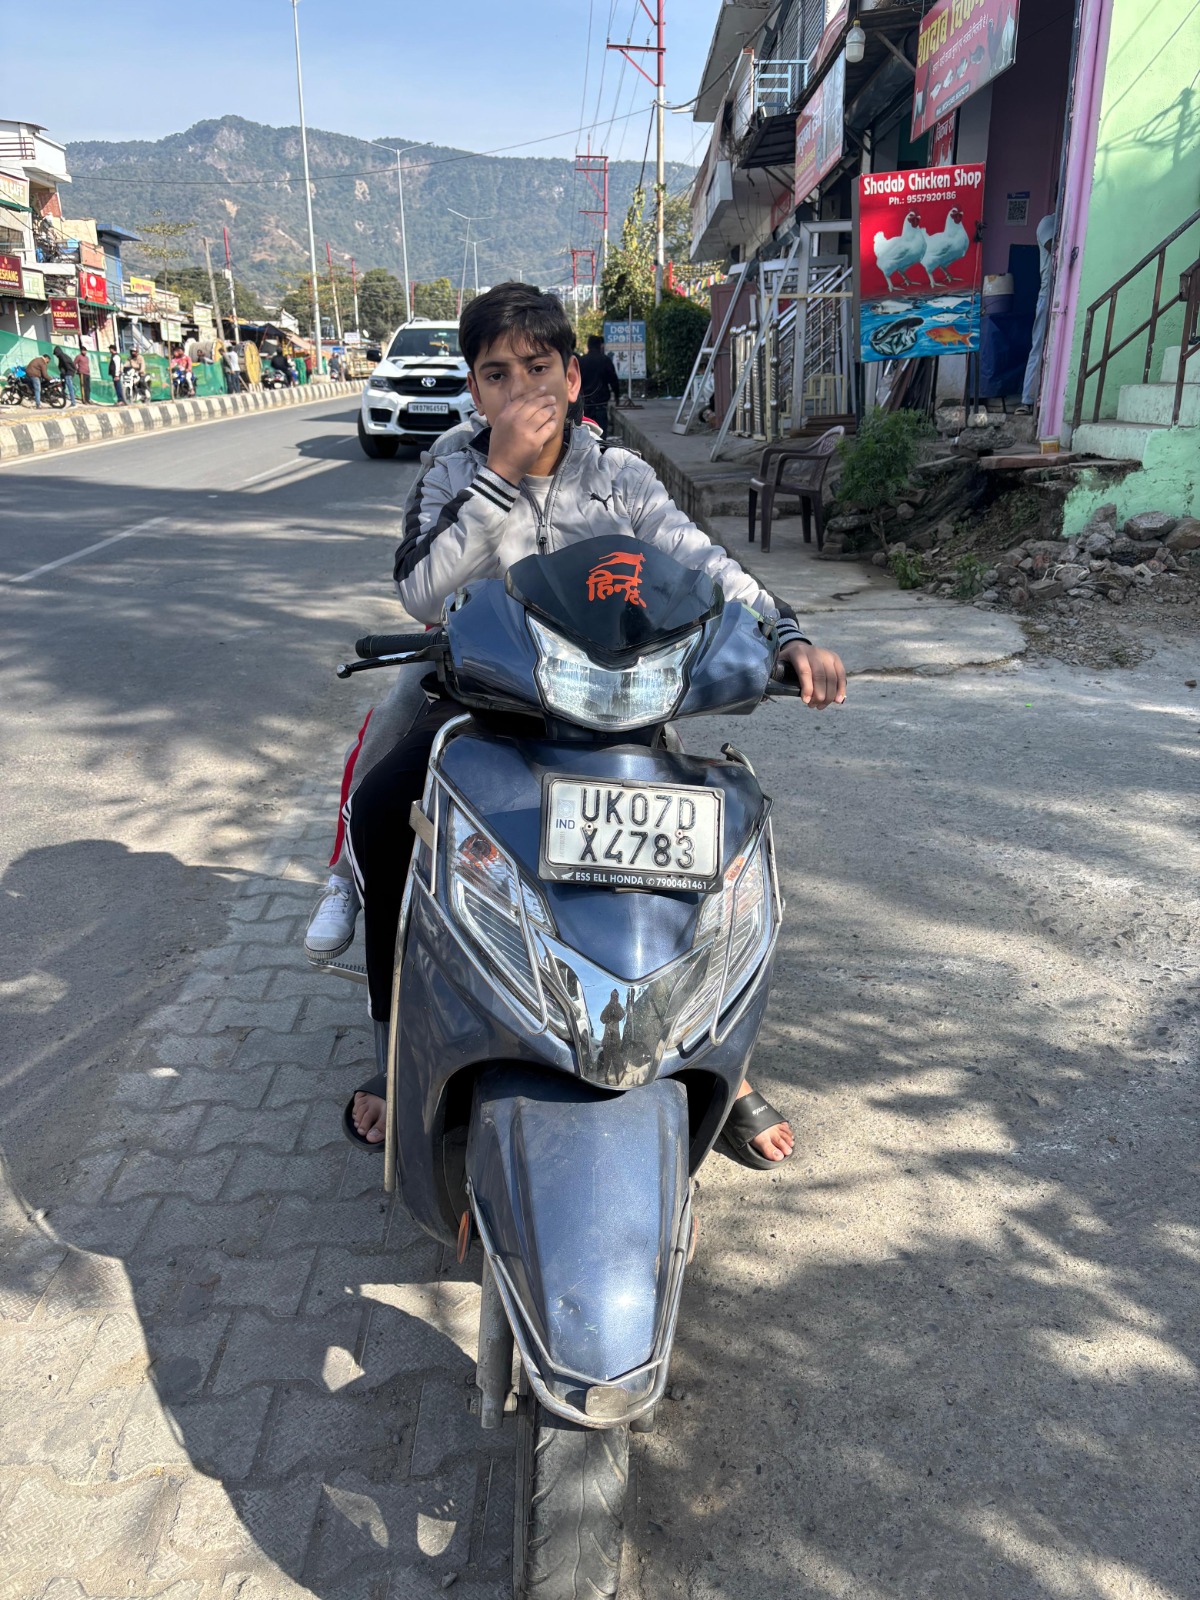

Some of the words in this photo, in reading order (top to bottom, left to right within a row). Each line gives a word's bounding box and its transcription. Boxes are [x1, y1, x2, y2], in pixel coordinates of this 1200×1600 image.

[918, 7, 949, 69] शादाब
[950, 0, 984, 37] चिक
[864, 175, 905, 195] Shadab
[908, 172, 950, 191] Chicken
[954, 168, 982, 189] Shop
[888, 196, 905, 206] Ph.:
[906, 191, 957, 204] 9557920186
[607, 334, 643, 343] SPORTS
[610, 325, 640, 334] DOON
[580, 788, 697, 831] UK07D
[555, 818, 576, 831] IND
[579, 827, 695, 869] X4783
[575, 871, 591, 882] ESS
[593, 873, 608, 883] ELL
[610, 874, 644, 886] HONDA
[656, 877, 707, 890] 7900461461
